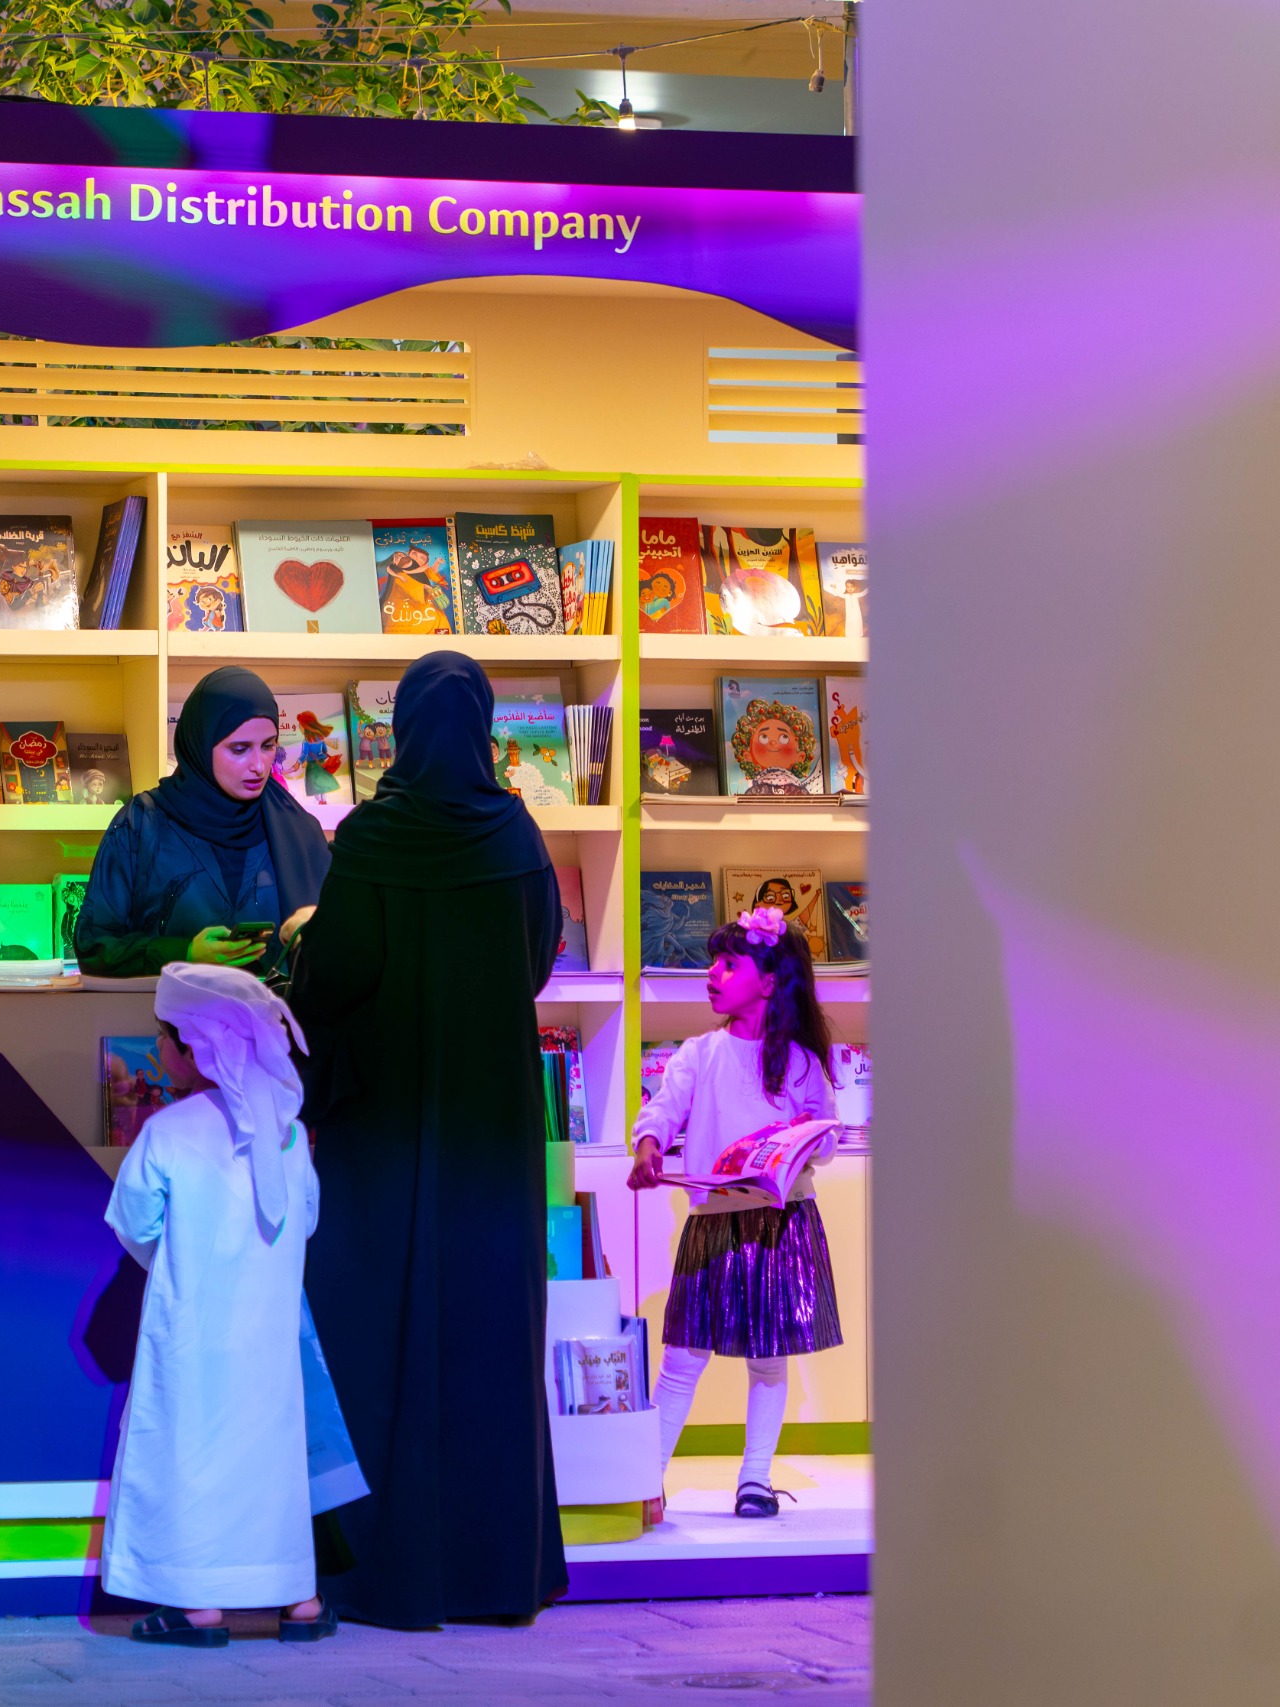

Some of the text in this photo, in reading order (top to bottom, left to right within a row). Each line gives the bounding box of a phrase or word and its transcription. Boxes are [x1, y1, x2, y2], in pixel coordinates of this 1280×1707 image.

[130, 182, 412, 231] Distribution
[428, 195, 641, 254] Company
[25, 530, 44, 542] قرية
[641, 529, 676, 545] ماما
[675, 725, 706, 735] الطفولة
[19, 739, 47, 749] رمضان
